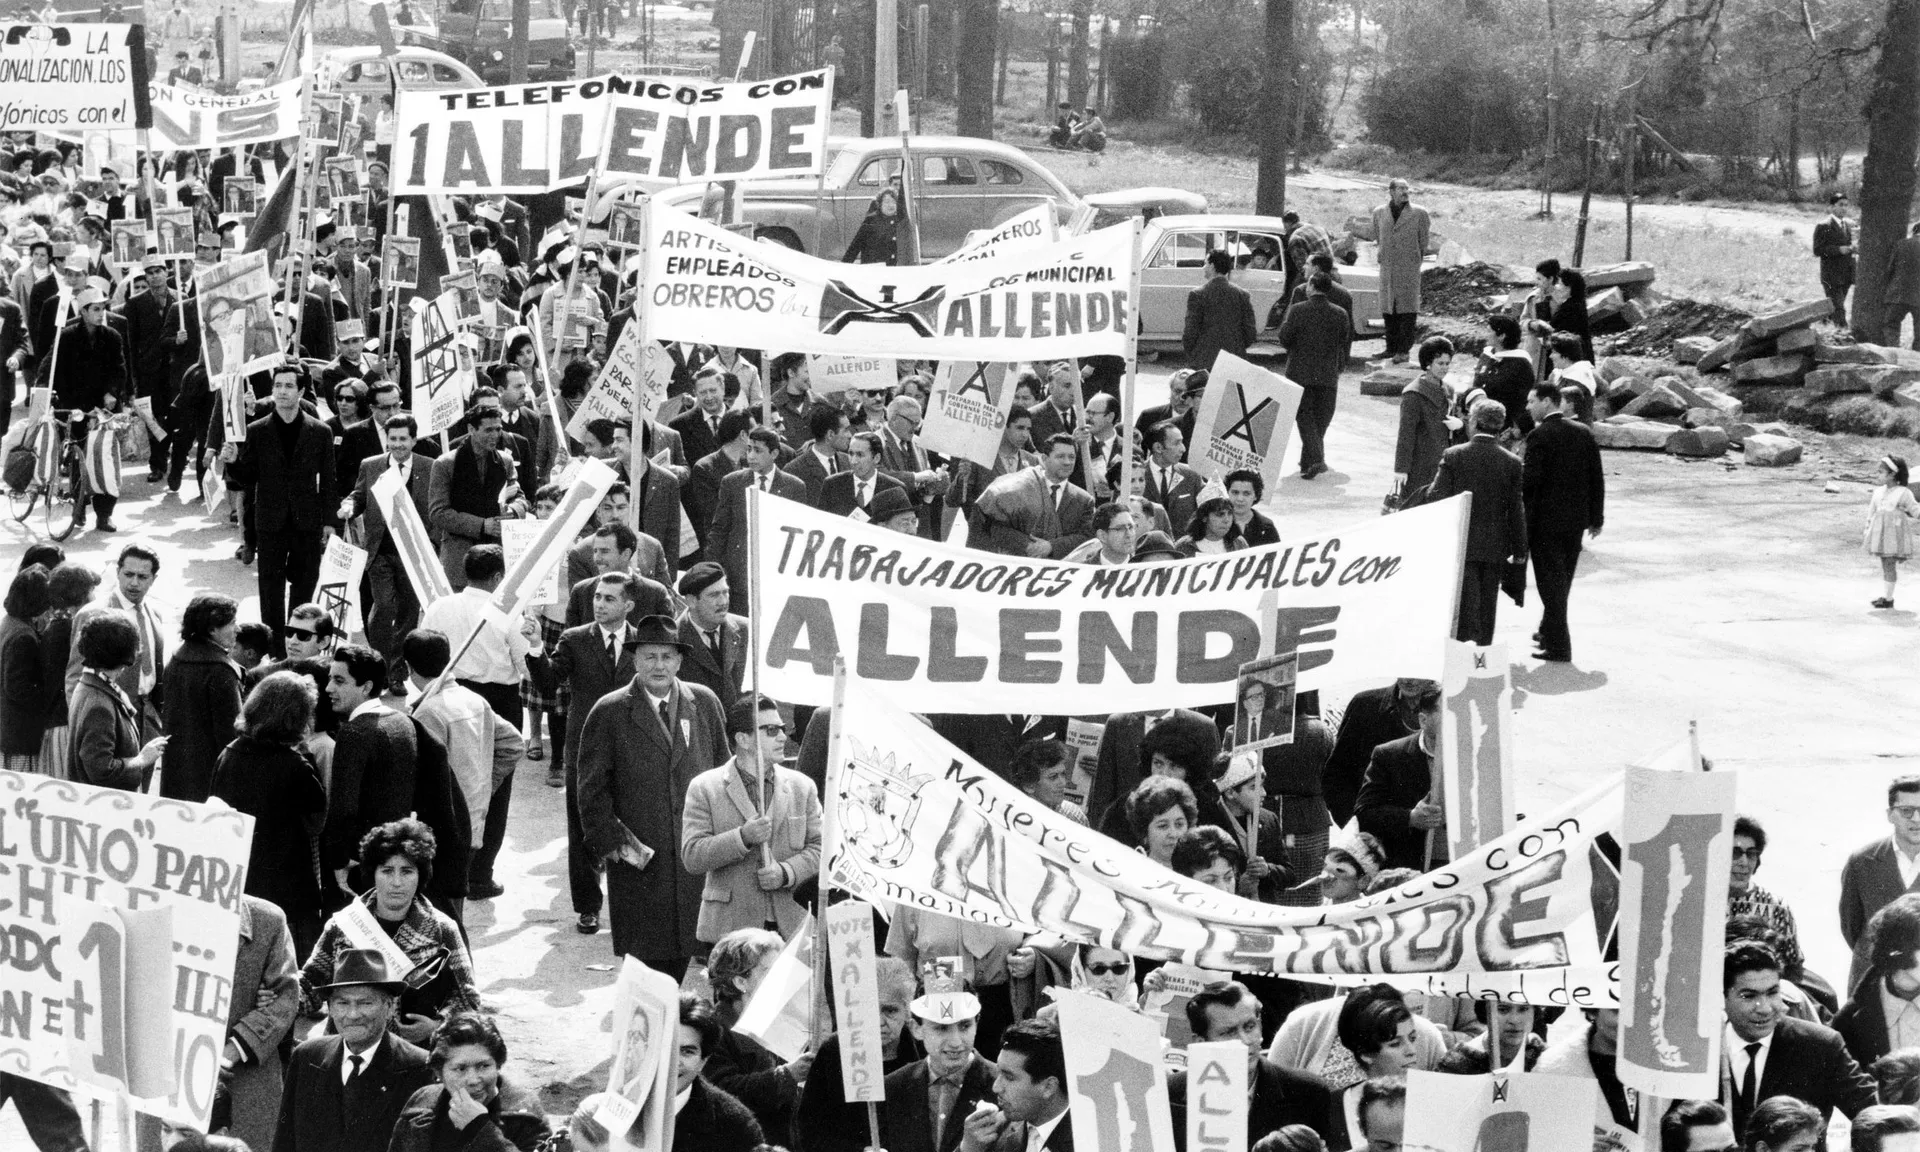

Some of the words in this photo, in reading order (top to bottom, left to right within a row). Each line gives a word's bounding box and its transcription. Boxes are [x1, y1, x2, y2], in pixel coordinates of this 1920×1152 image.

[86, 31, 109, 54] LA
[99, 59, 126, 84] LOS
[440, 75, 724, 111] TELEFONICOS
[747, 71, 827, 98] CON
[78, 107, 107, 124] con
[112, 98, 127, 123] el
[442, 105, 818, 188] ALLENDE
[666, 256, 796, 287] EMPLEADOS
[1025, 266, 1116, 283] MUNICIPAL
[653, 283, 775, 312] OBREROS
[943, 290, 1127, 338] ALLENDE
[827, 360, 880, 376] ALLENDE
[944, 407, 995, 430] ALLENDE
[779, 526, 1077, 600] TRABAJADORES
[1082, 537, 1341, 600] MUNICIPALES
[1340, 554, 1402, 588] con
[766, 596, 1341, 686] ALLENDE
[152, 843, 245, 916] PARA
[931, 797, 1571, 973] ALLENDE
[829, 917, 872, 936] VOTE
